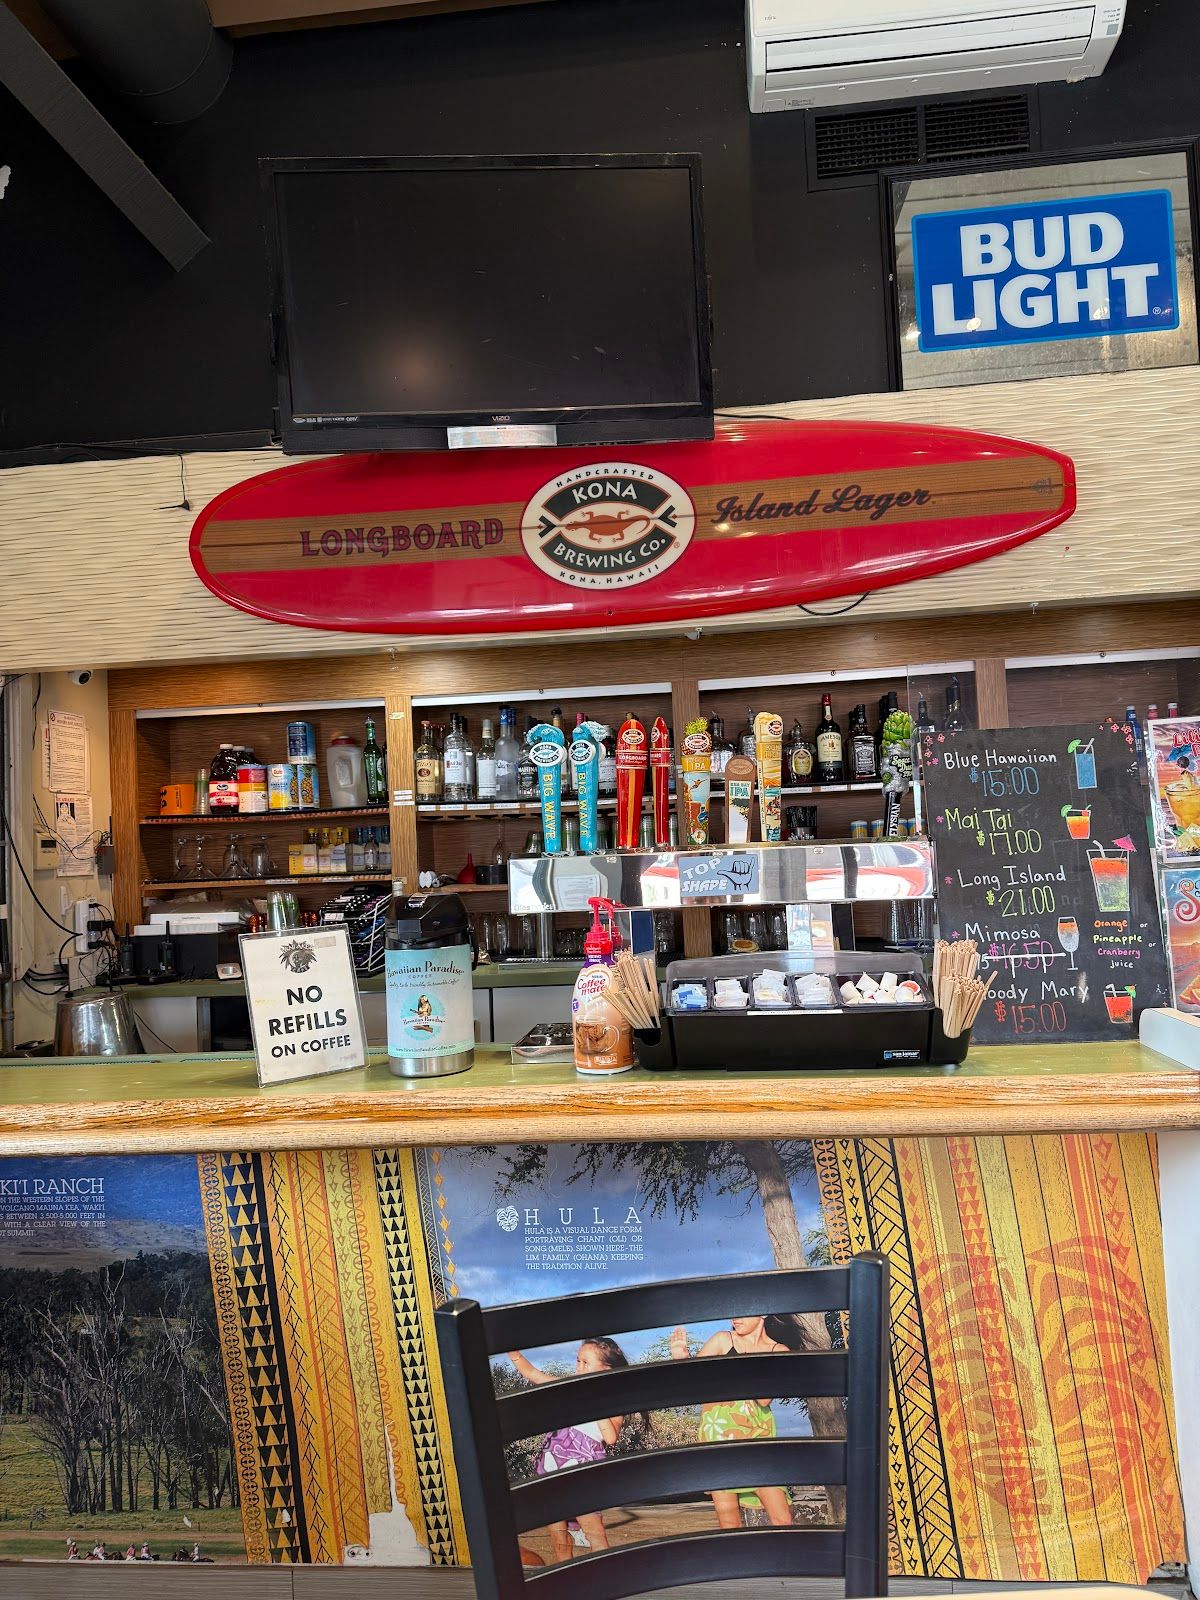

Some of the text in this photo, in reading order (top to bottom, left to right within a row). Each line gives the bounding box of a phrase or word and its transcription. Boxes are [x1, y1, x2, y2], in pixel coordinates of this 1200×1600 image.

[960, 211, 1124, 277] BUD
[931, 263, 1159, 336] LIGHT
[556, 468, 655, 488] HANDCRAFTED
[572, 481, 638, 504] KONA
[711, 484, 930, 524] Island Lager
[300, 518, 504, 558] LONGBOARD
[553, 537, 666, 569] BREWING CO.
[559, 564, 659, 585] KONA, HAWAII
[944, 749, 1057, 770] Blue Hawaiian
[577, 772, 587, 795] BIG
[730, 786, 750, 797] IPA
[543, 773, 556, 840] BIG WAVE
[579, 799, 588, 837] WAVE
[945, 807, 1013, 831] Mai Tai
[976, 829, 1042, 856] $17.00
[682, 858, 721, 880] TOP
[957, 864, 1066, 891] Long Island
[681, 879, 728, 893] SHAPE
[965, 922, 1041, 943] Mimosa
[1094, 920, 1128, 932] Orange
[1093, 934, 1143, 945] Pineapple
[1098, 948, 1141, 959] Cranberry
[425, 961, 463, 976] Paradise
[1110, 960, 1133, 969] juice
[577, 978, 606, 990] Coffee
[581, 984, 606, 996] mate
[1041, 980, 1089, 1004] Mary
[286, 985, 323, 1006] NO
[268, 1008, 347, 1037] REFILLS
[994, 1001, 1067, 1034] $15.00
[271, 1035, 350, 1058] ON COFFEE
[33, 1178, 105, 1195] RANCH
[524, 1206, 642, 1226] HULA
[525, 1227, 545, 1235] HULA
[562, 1226, 589, 1234] VISUAL
[591, 1226, 618, 1234] DANCE
[525, 1236, 573, 1244] PORTRAYING
[576, 1244, 605, 1252] SHOWN
[541, 1262, 582, 1270] TRADITION
[584, 1262, 609, 1270] ALIVE.
